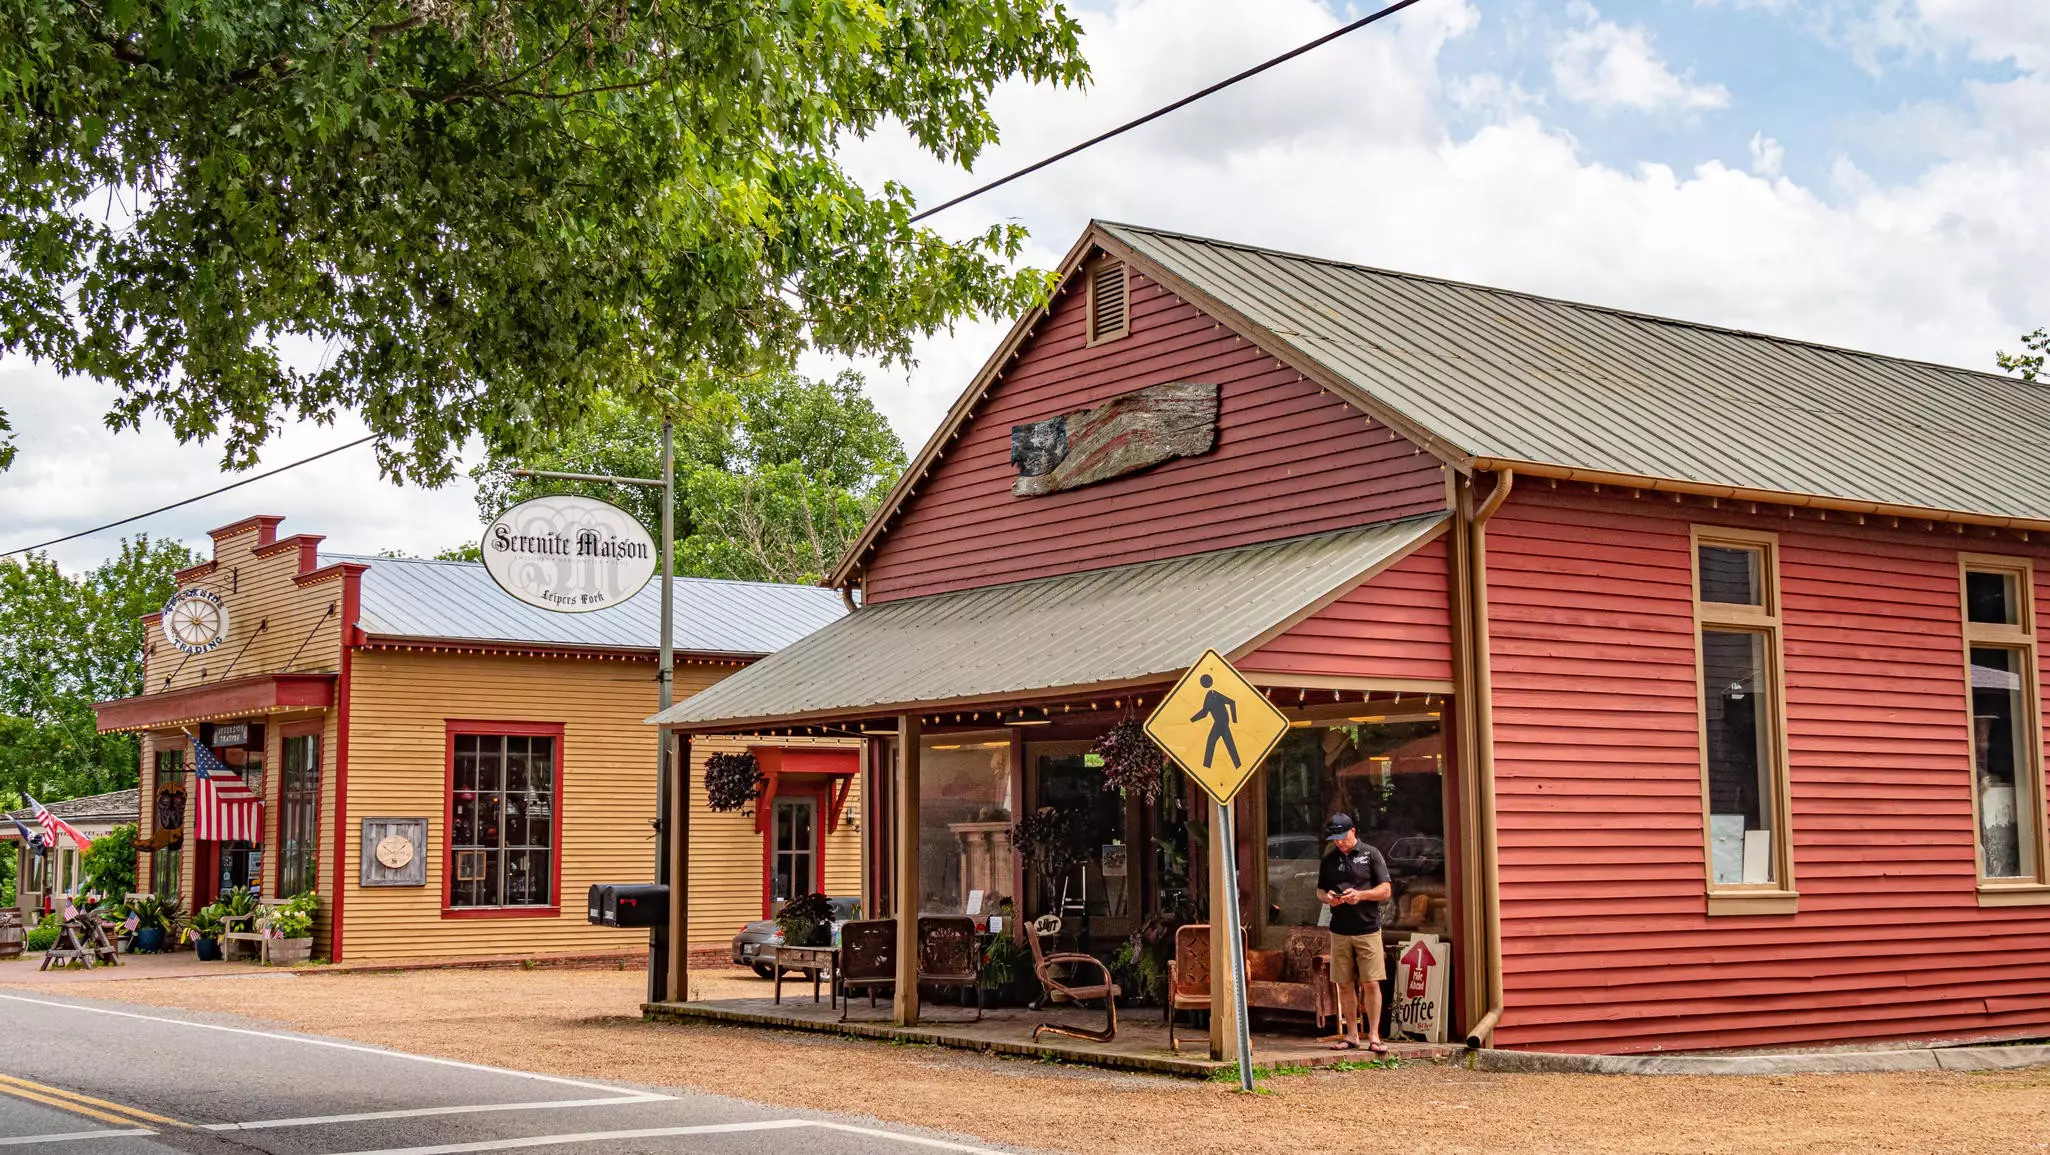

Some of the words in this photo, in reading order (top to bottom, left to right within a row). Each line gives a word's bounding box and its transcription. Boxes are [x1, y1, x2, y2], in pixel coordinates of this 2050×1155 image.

[491, 523, 570, 555] Serenite
[576, 527, 649, 560] Maison
[542, 590, 577, 607] Leipers
[581, 592, 605, 605] Fork
[173, 636, 223, 655] TRADING
[1409, 980, 1425, 991] Ahead
